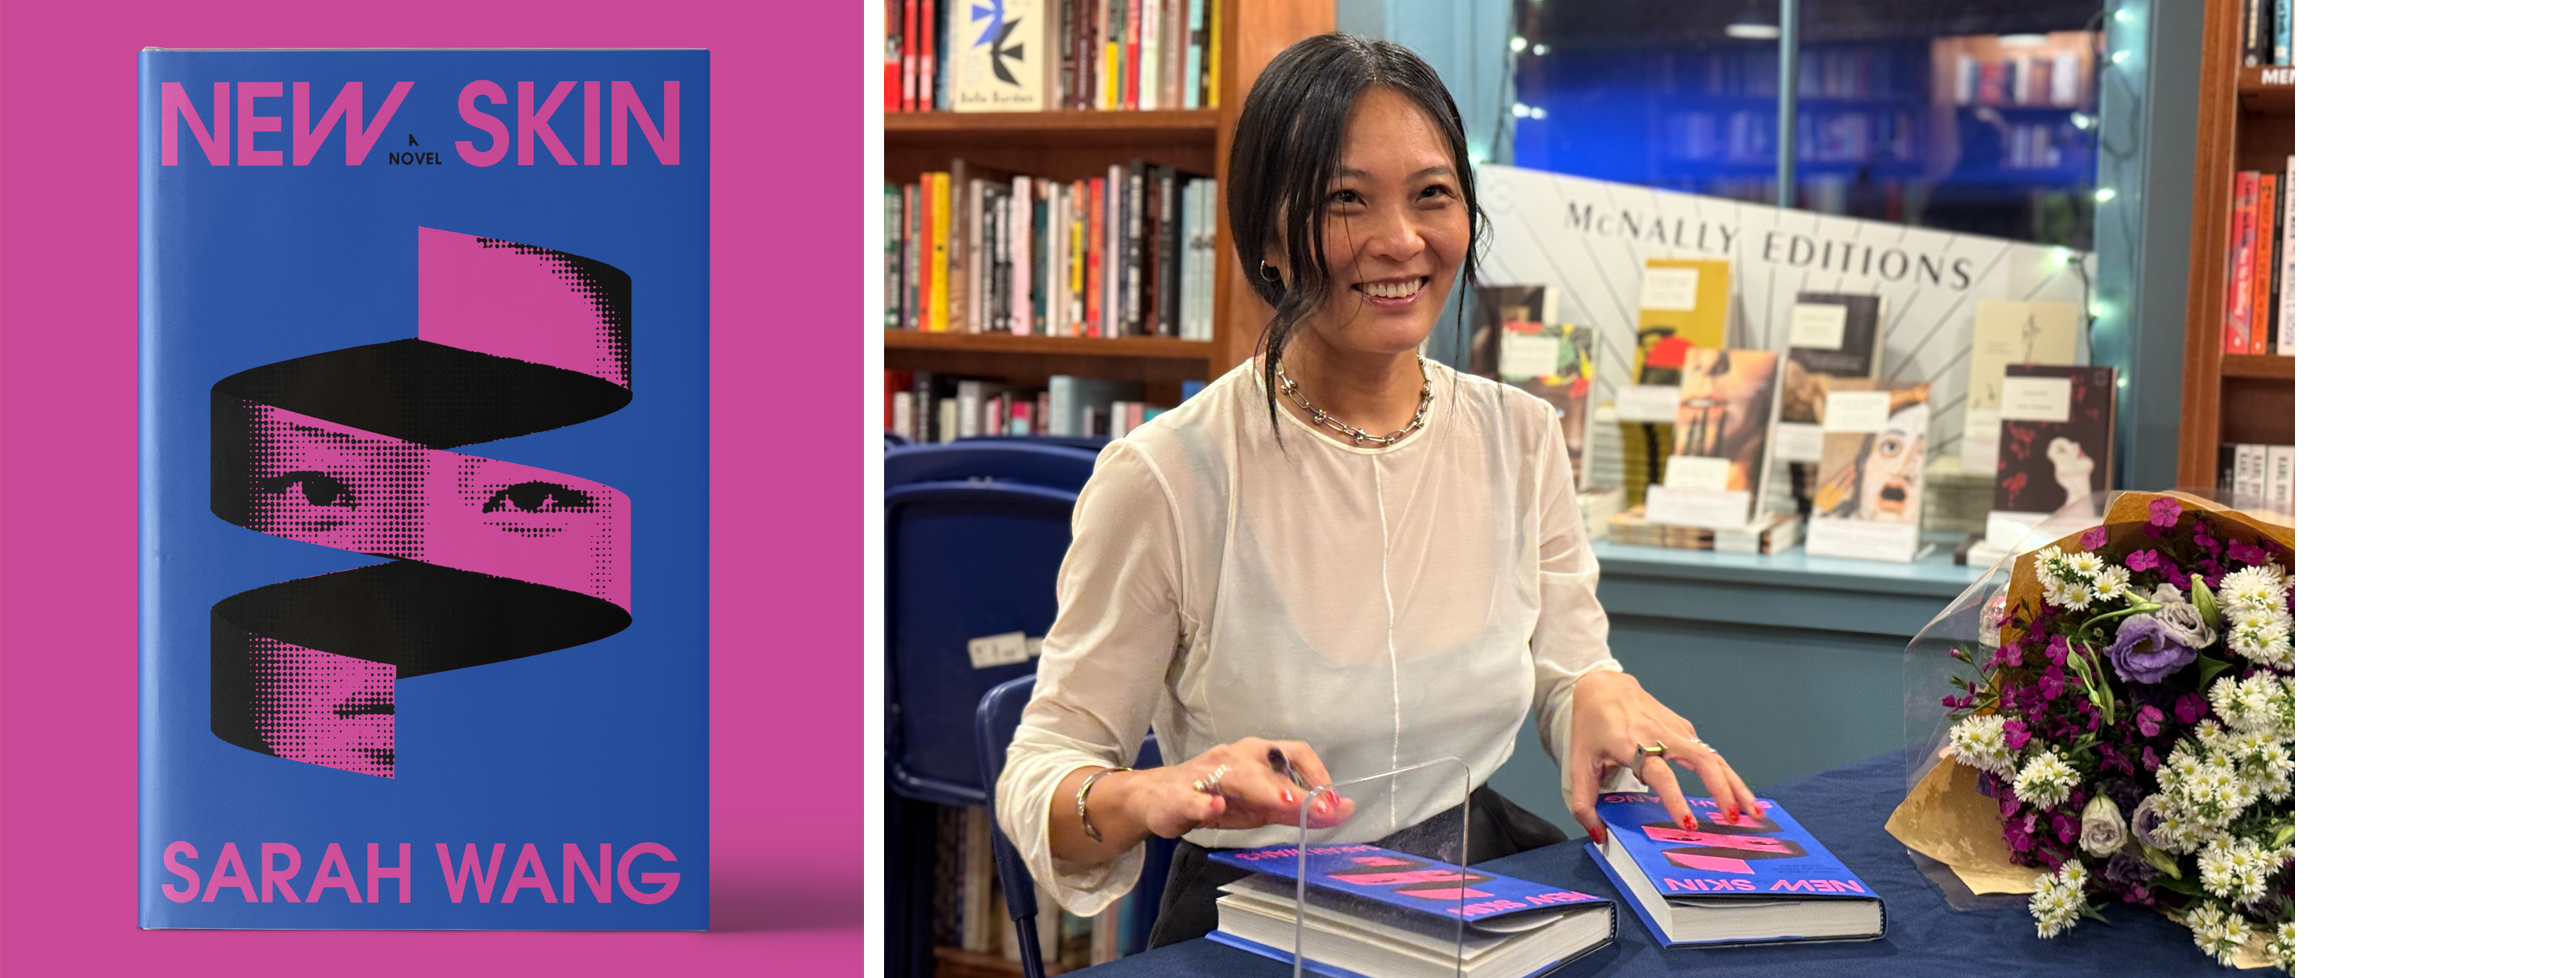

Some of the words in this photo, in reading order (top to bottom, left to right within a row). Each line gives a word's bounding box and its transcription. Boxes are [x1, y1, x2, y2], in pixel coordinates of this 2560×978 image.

[162, 82, 415, 167] NEW
[455, 80, 680, 167] SKIN
[409, 133, 419, 147] A
[389, 152, 442, 165] NOVEL
[1566, 201, 1741, 255] McNALLY
[1762, 230, 1974, 292] EDITIONS
[1604, 795, 1661, 804] ANG
[162, 841, 411, 903] SARAH
[435, 841, 680, 904] WANG
[1663, 878, 1756, 892] SKIN
[1770, 879, 1865, 893] NEW
